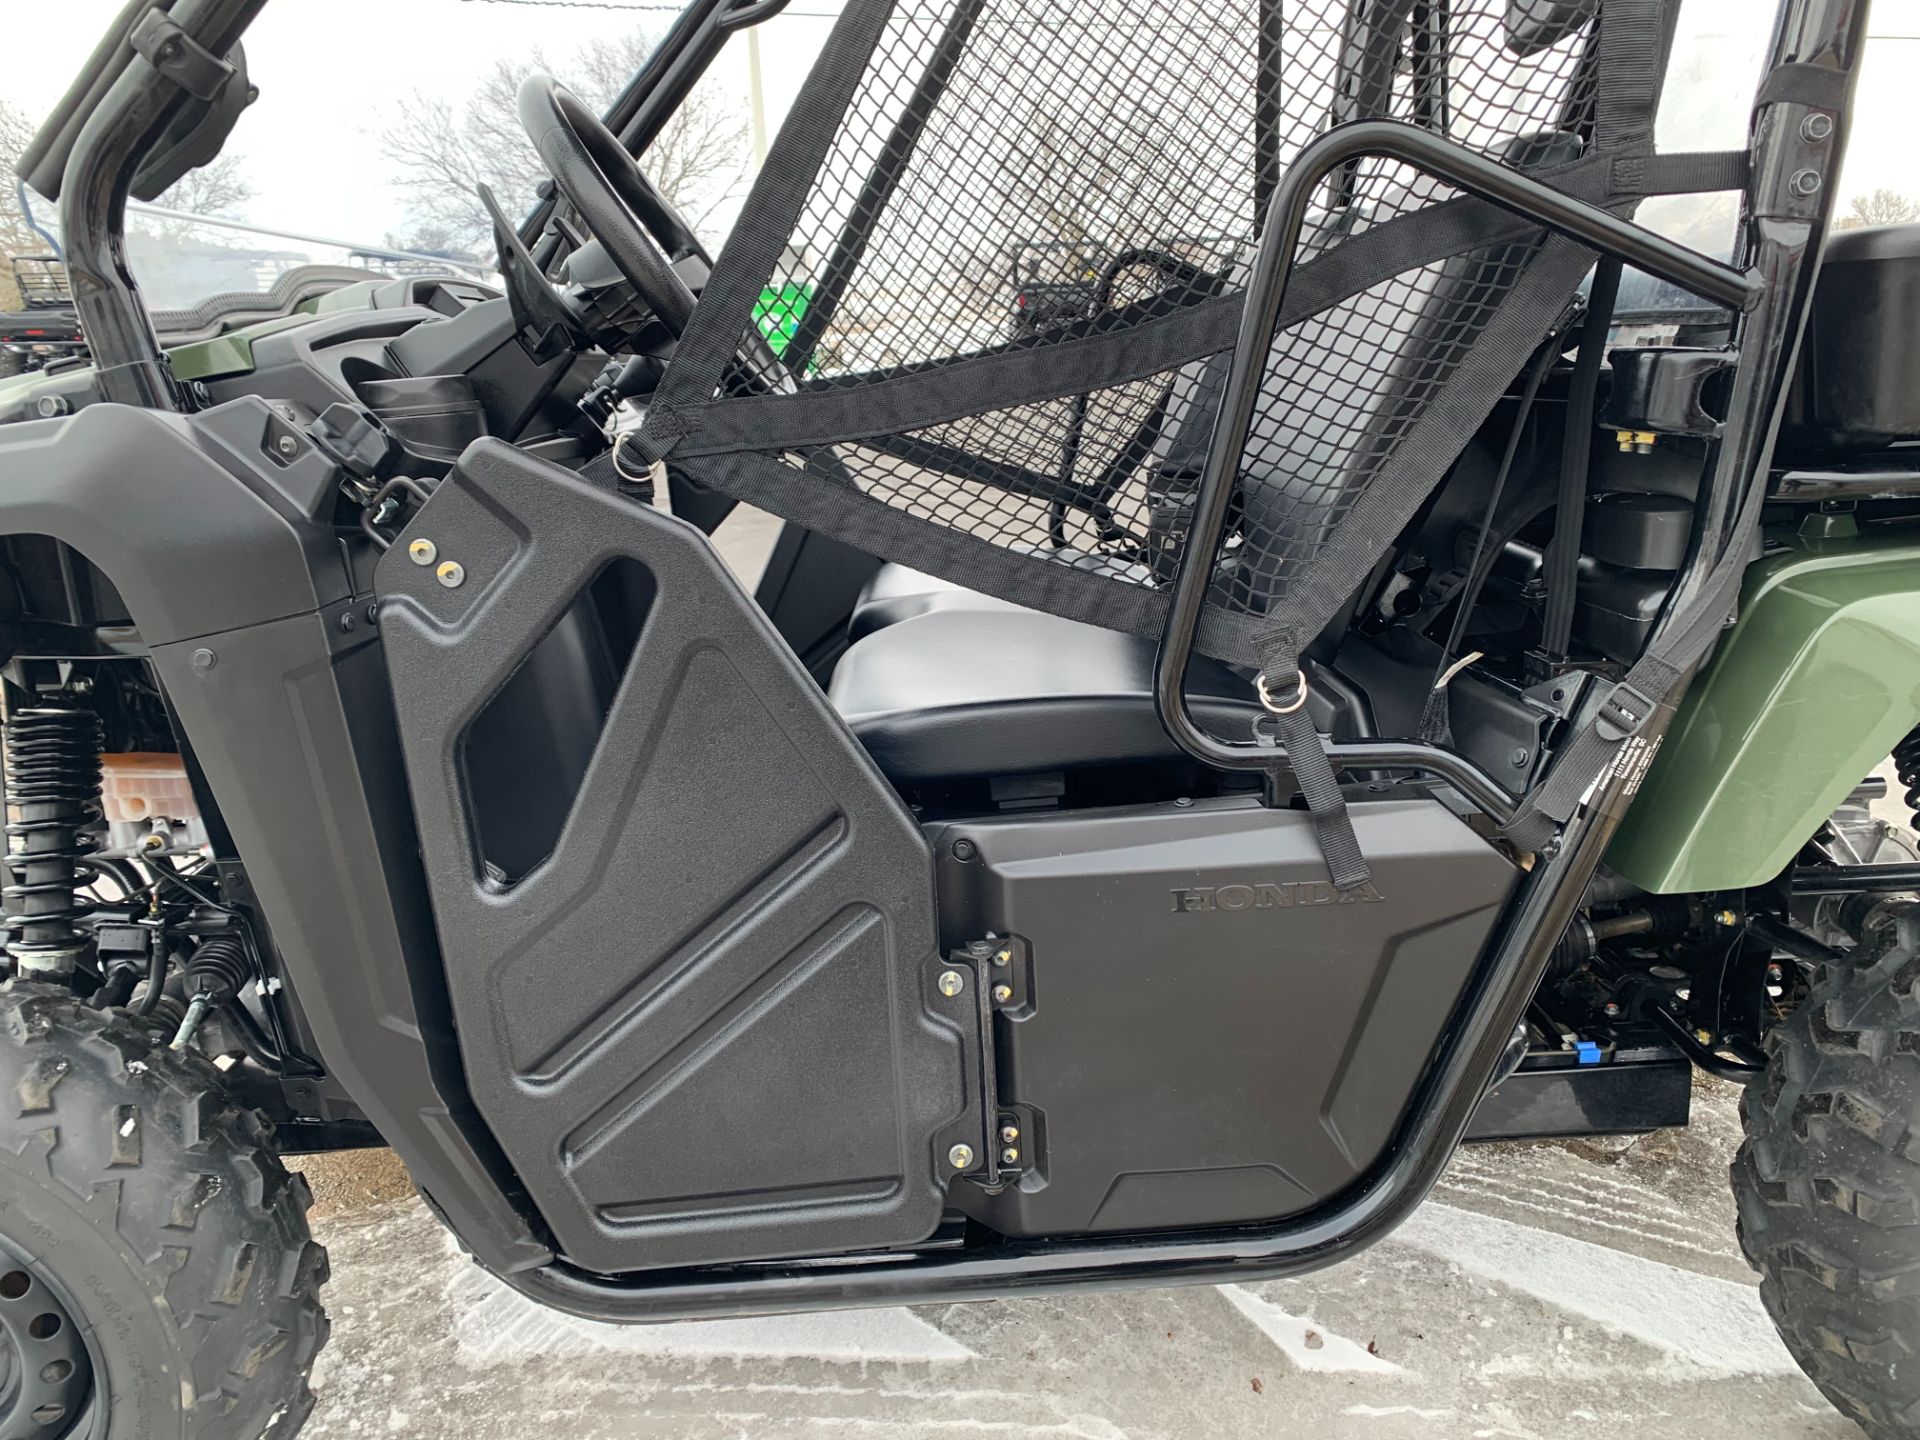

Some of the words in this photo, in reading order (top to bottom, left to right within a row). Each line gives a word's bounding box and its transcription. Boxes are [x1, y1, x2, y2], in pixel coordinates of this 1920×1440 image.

[1610, 749, 1624, 768] Honda
[1614, 763, 1624, 777] 1111
[1620, 746, 1634, 765] Honda
[1630, 736, 1641, 748] Way
[1169, 880, 1386, 913] HONDA
